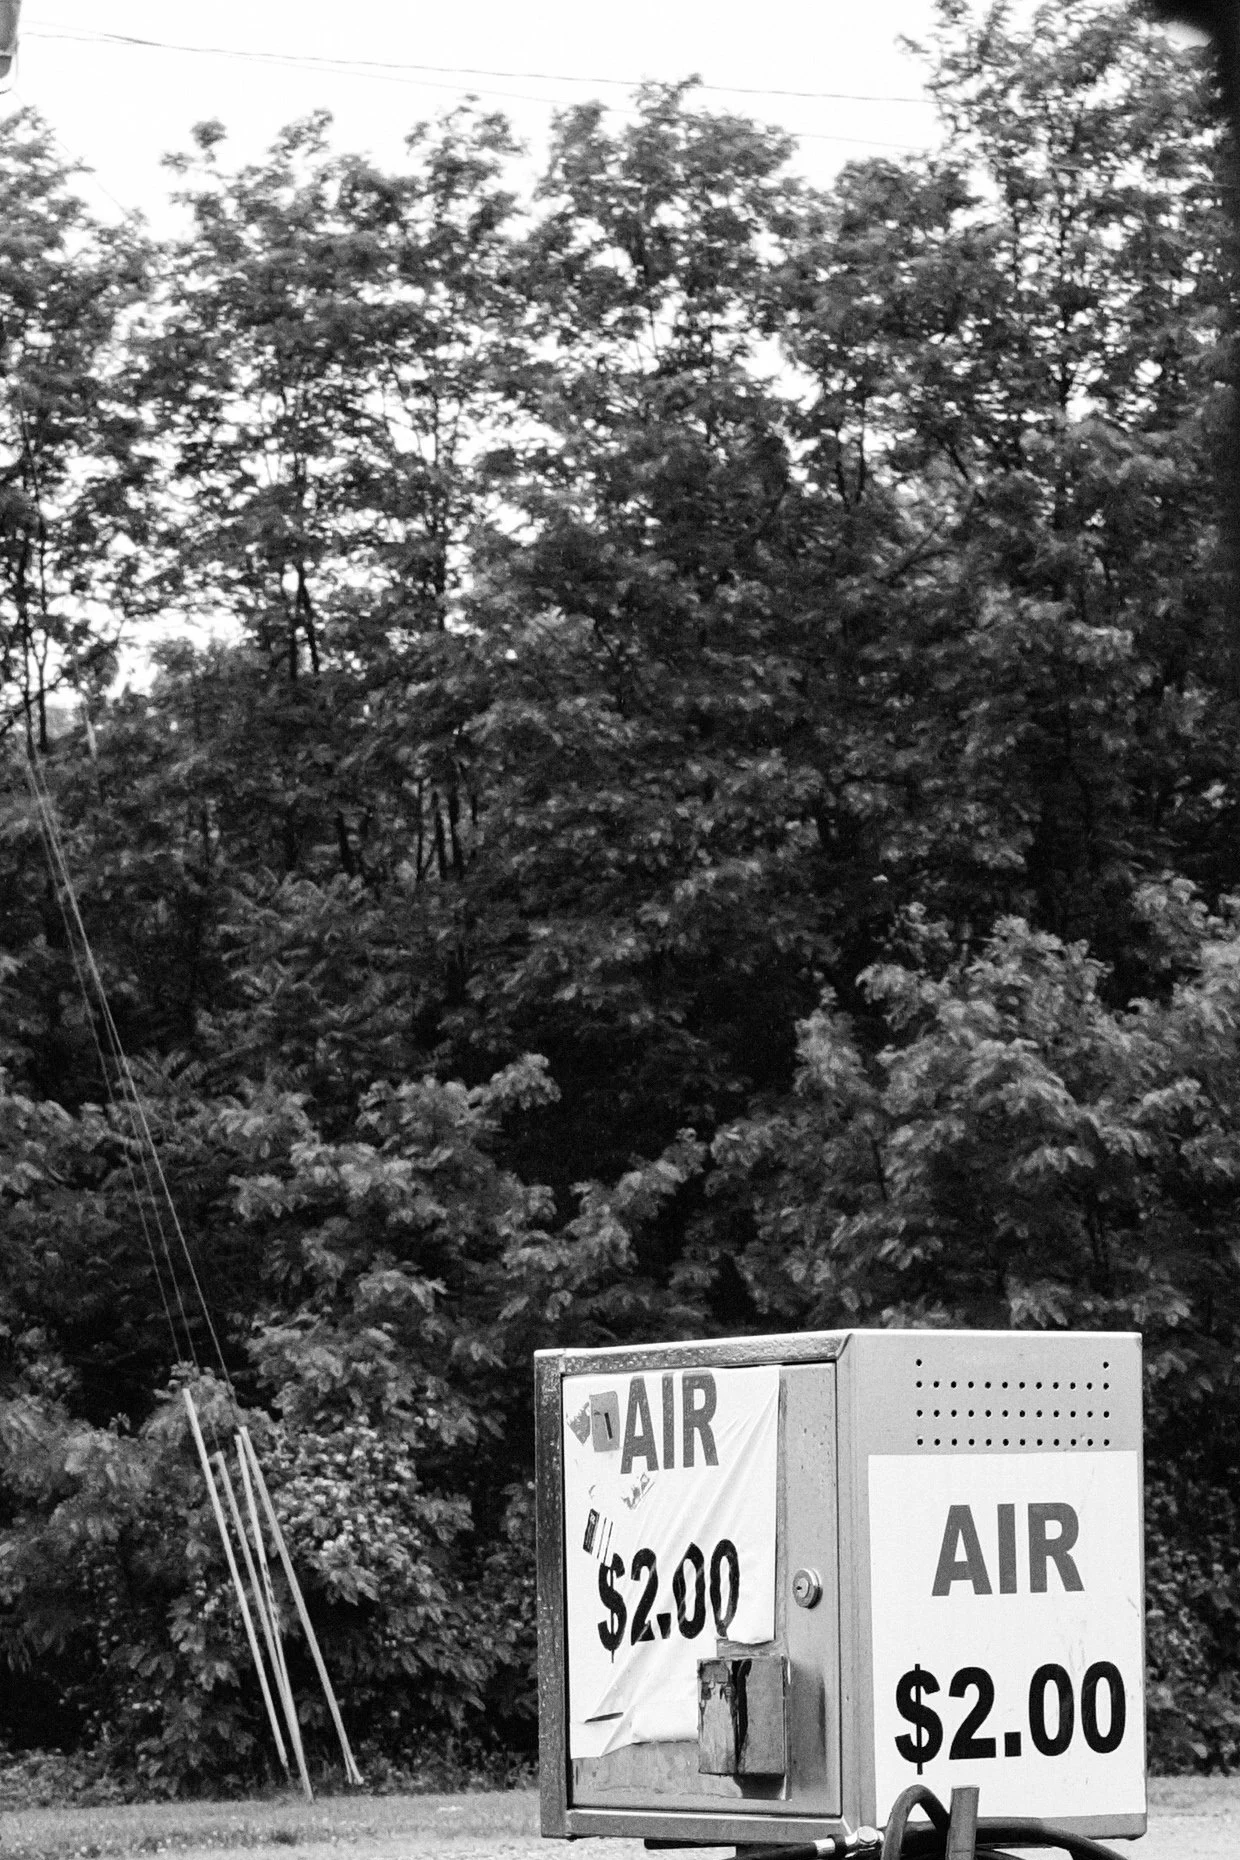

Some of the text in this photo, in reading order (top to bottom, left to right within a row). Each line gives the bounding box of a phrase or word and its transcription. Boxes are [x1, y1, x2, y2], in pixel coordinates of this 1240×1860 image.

[620, 1368, 719, 1475] AIR
[597, 1538, 741, 1664] $2.00
[931, 1501, 1085, 1597] AIR
[894, 1660, 1127, 1776] $2.00
